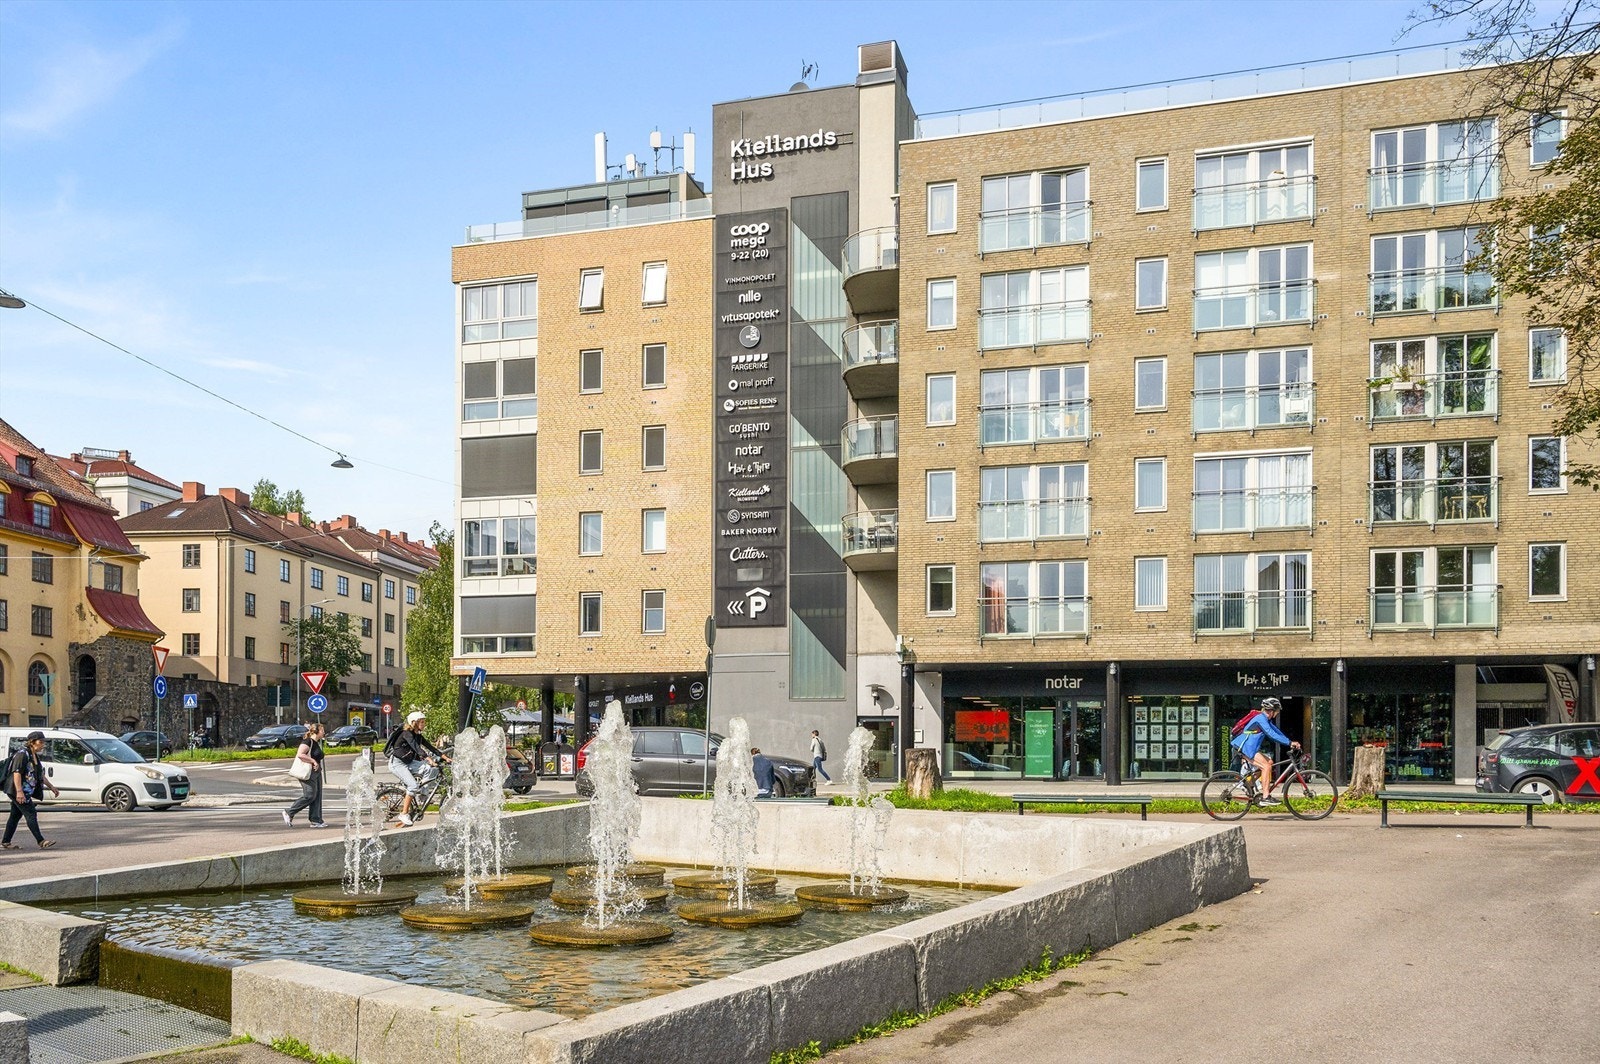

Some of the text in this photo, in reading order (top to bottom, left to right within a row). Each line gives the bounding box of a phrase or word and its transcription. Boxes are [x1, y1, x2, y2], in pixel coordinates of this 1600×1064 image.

[730, 128, 837, 158] Kiellands
[730, 160, 773, 180] Hus
[730, 222, 770, 236] coop
[730, 235, 765, 248] mega
[731, 248, 769, 260] 9-22 (20)
[725, 273, 776, 284] VINMONOPOLET
[738, 290, 762, 303] nille
[731, 362, 768, 371] FARGERIKE
[740, 376, 775, 388] mal proff
[735, 397, 778, 407] SOFIES RENS
[735, 444, 763, 455] notar
[721, 528, 745, 536] BAKER
[749, 596, 767, 618] P
[1045, 675, 1083, 689] notar
[1237, 671, 1258, 687] Hair
[644, 693, 654, 702] Hus
[1221, 725, 1229, 771] GYMGROSSISTE
